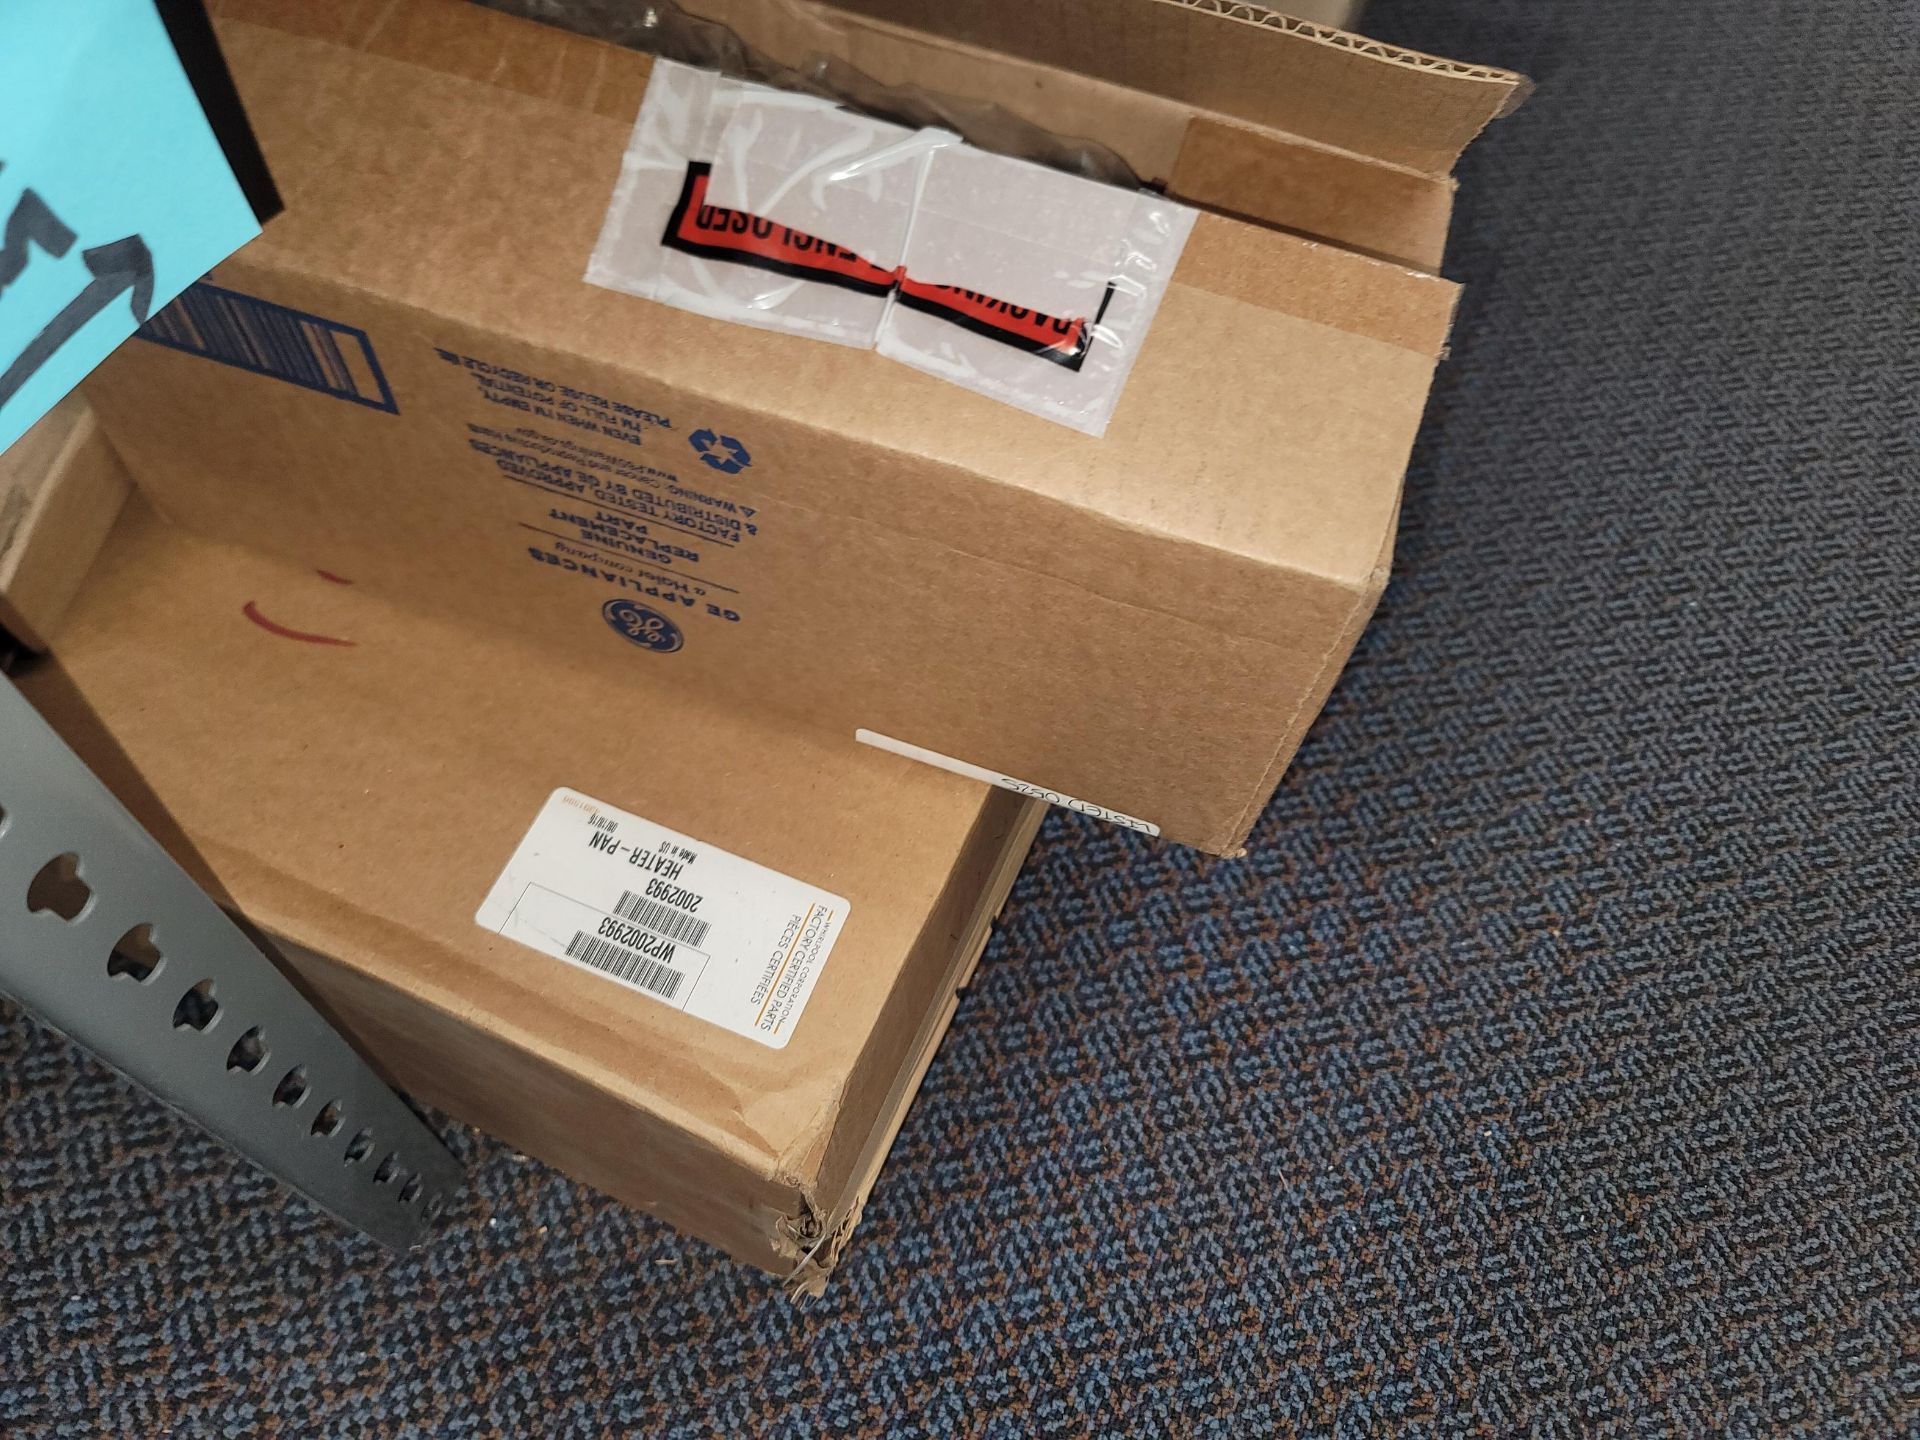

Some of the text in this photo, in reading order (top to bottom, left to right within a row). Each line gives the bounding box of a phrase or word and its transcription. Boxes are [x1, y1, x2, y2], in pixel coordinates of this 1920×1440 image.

[462, 356, 530, 385] RECYCLE
[533, 378, 554, 392] OR
[558, 386, 609, 409] REUSE
[534, 407, 554, 419] I'M
[559, 401, 578, 412] OF
[580, 406, 617, 424] FULL
[612, 402, 670, 428] PLEASE
[556, 413, 600, 433] WHEN
[602, 426, 641, 446] EVEN
[622, 419, 640, 432] I'M
[468, 439, 758, 536] & DISTRIBUTED BY GE APPLIANCES
[615, 470, 660, 488] Cancer
[496, 460, 740, 542] FACTORY TESTED, APPROVED
[548, 509, 699, 562] REPLACEMENT
[595, 512, 648, 536] PART
[581, 530, 672, 565] GENUINE
[554, 542, 706, 596] a Haier company
[528, 548, 740, 622] GE APPLIANCES
[658, 841, 697, 864] Made in US
[645, 878, 703, 912] 2002993
[598, 917, 676, 963] WP2002993
[751, 914, 801, 1005] PIÈCES CERTIFIÉES
[760, 905, 827, 1031] FACTORY CERTIFIED PARTS
[779, 922, 831, 1023] WHIRLPOOL CORPORATION
